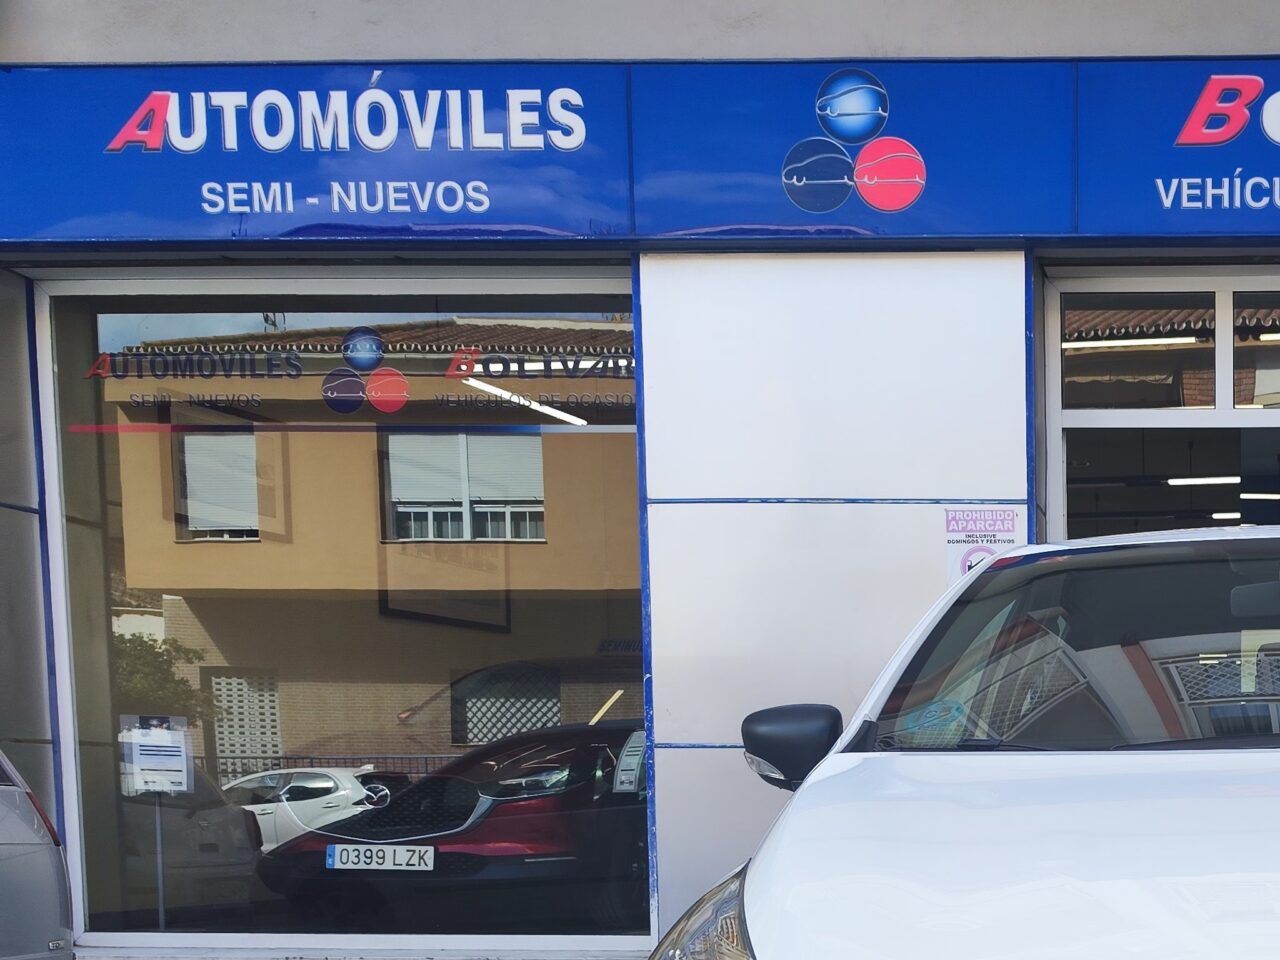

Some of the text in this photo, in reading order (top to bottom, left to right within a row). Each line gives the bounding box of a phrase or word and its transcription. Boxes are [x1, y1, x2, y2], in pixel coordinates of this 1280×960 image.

[103, 70, 586, 153] AUTOMÓVILES
[201, 181, 293, 214] SEMI
[331, 180, 490, 214] NUEVOS
[539, 392, 561, 408] DE
[948, 511, 1014, 520] PROHIBIDO
[948, 520, 1014, 531] APARCAR
[339, 848, 429, 867] 0399 LZK
